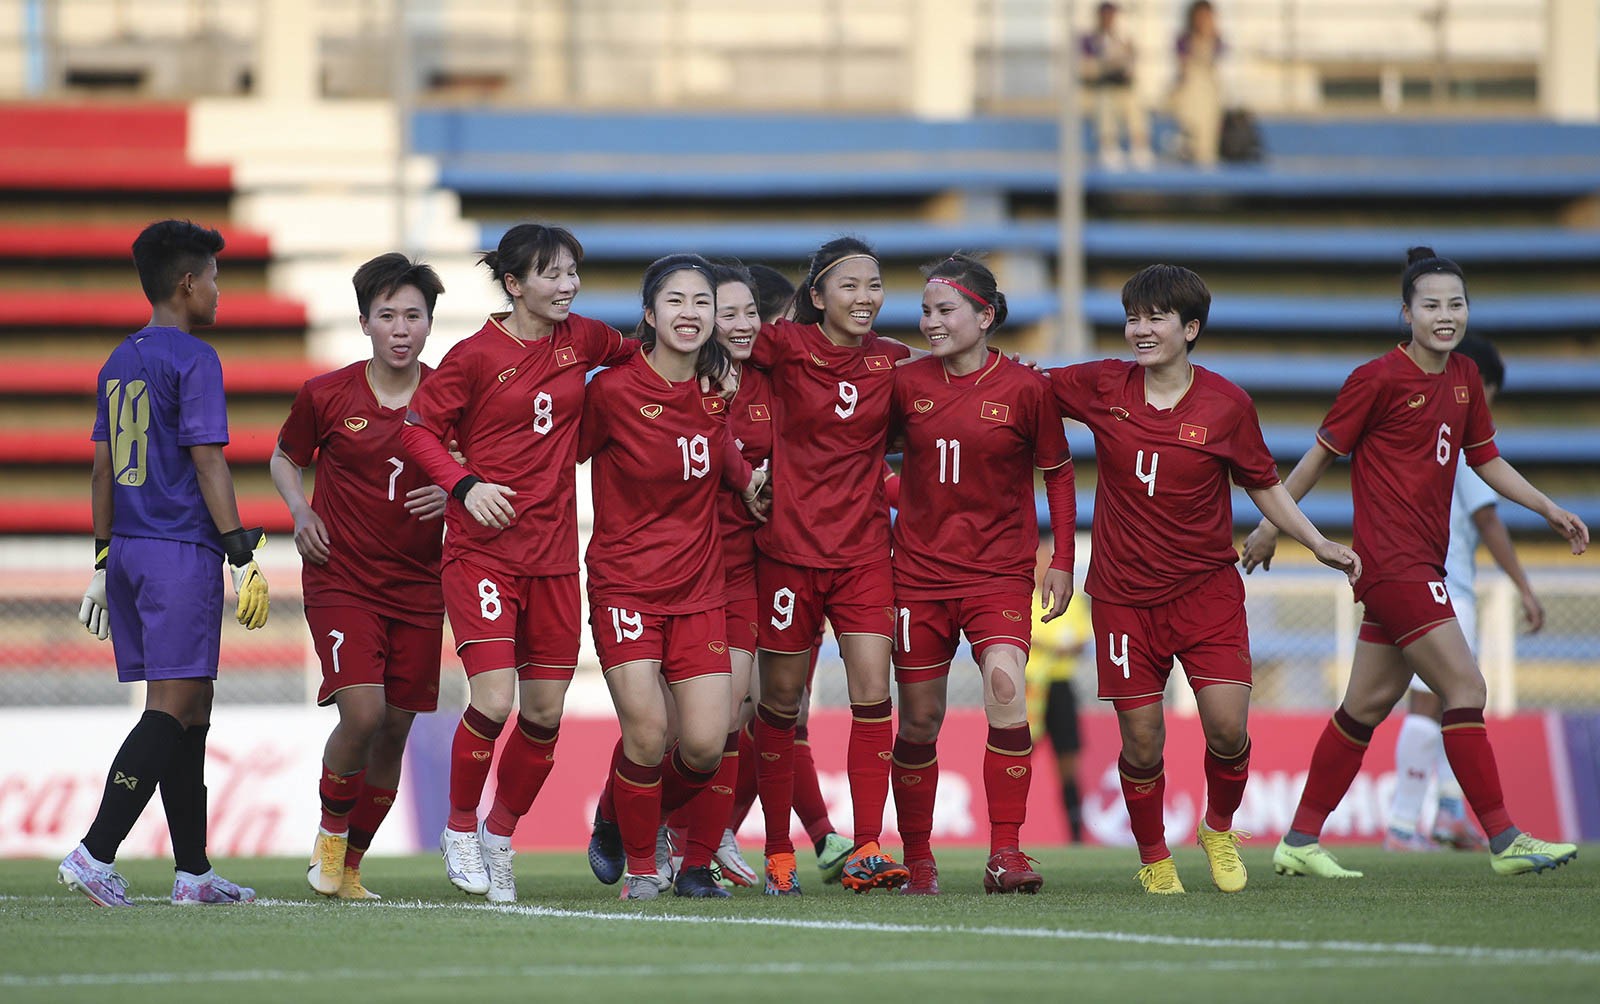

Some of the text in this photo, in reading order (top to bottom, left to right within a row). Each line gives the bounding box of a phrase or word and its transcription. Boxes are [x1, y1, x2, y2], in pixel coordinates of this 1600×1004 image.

[534, 392, 553, 435] 8
[835, 381, 858, 419] 9
[106, 379, 149, 486] 18
[1437, 423, 1451, 466] 6
[677, 434, 709, 480] 19
[936, 438, 960, 483] 11
[1136, 450, 1158, 496] 4
[387, 457, 403, 501] 7
[478, 579, 502, 621] 8
[771, 587, 795, 630] 9
[607, 606, 643, 643] 19
[328, 630, 344, 672] 7
[1110, 633, 1129, 679] 4
